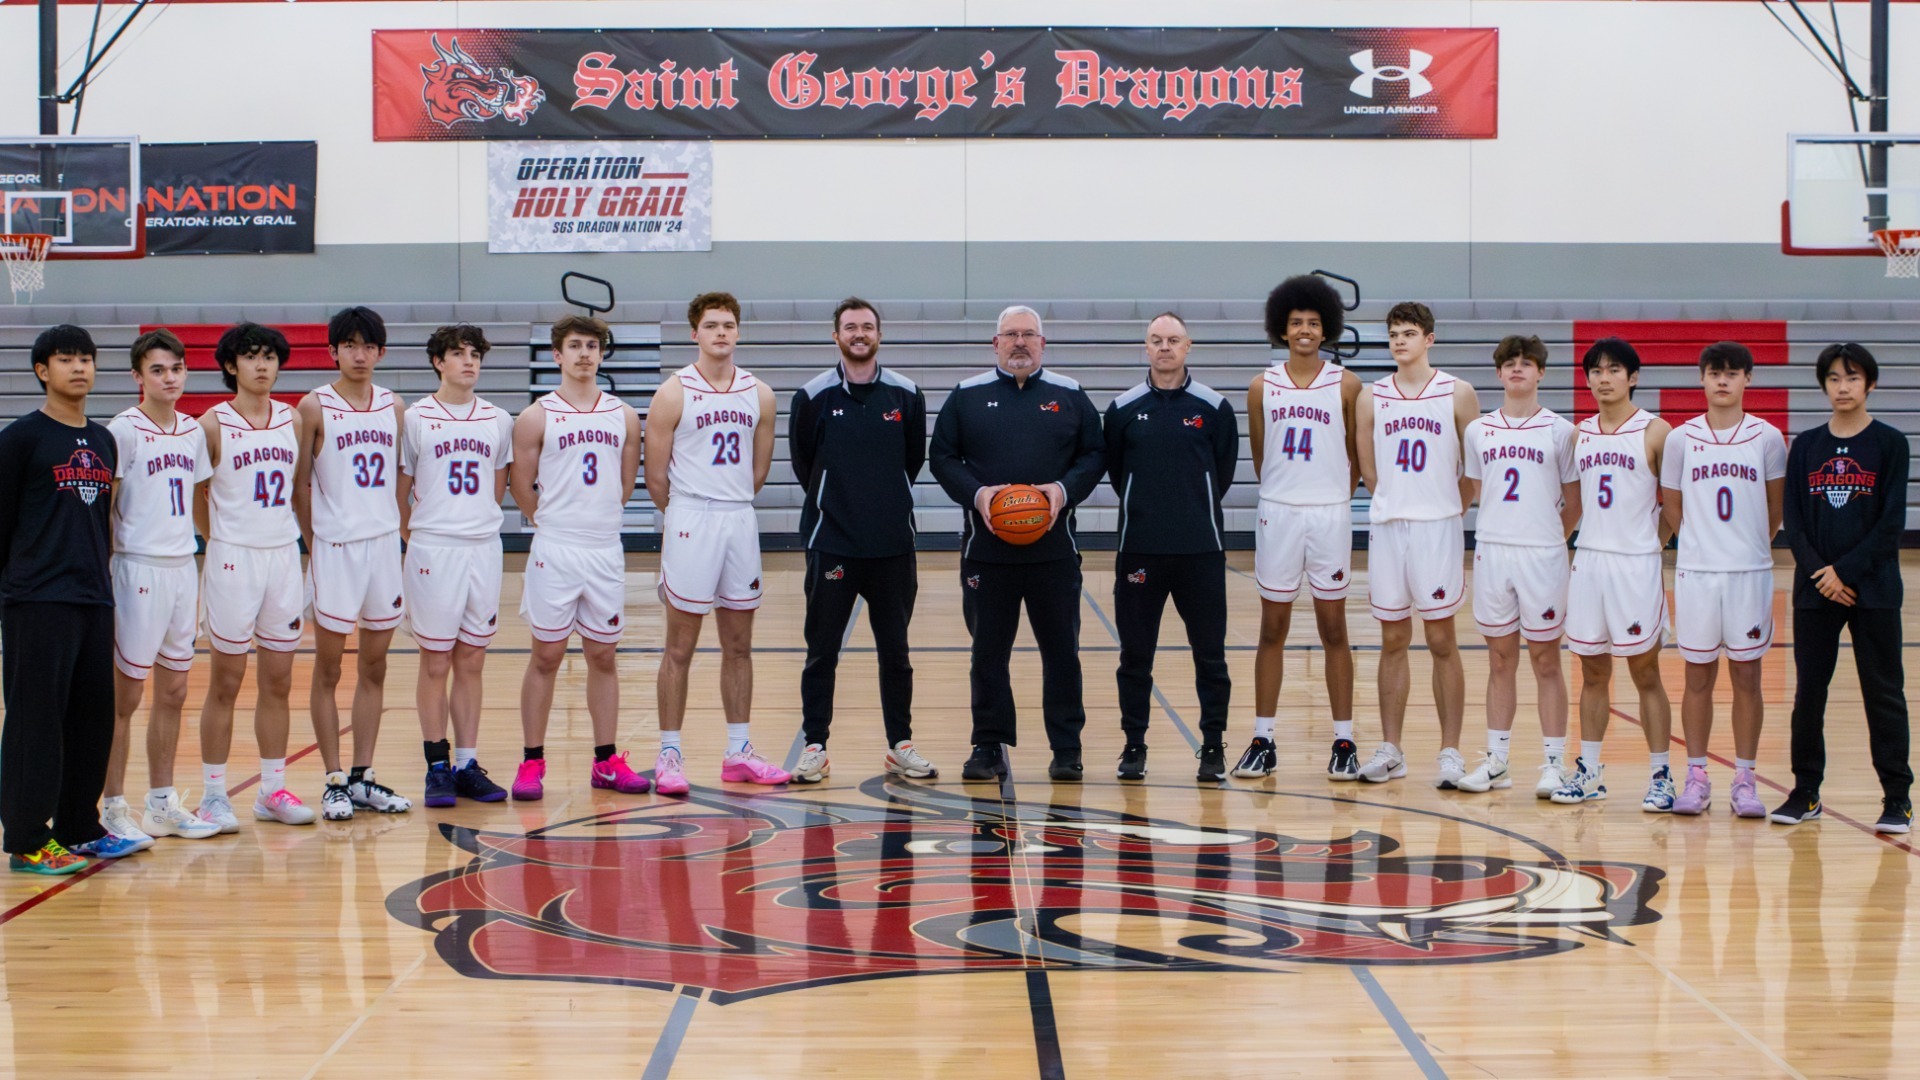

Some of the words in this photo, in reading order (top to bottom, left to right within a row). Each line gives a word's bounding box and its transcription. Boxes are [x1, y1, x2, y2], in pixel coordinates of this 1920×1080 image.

[571, 51, 740, 111] Saint
[768, 50, 1025, 121] George's
[1055, 49, 1304, 121] Dragons
[1344, 106, 1384, 114] UNDER
[1386, 106, 1438, 114] ARMOUR
[517, 157, 644, 180] OPERATION
[146, 183, 296, 212] NATION
[512, 187, 593, 218] HOLY
[597, 186, 687, 217] GRAIL
[124, 217, 210, 228] OERATION:
[212, 215, 251, 227] HOLY
[253, 215, 297, 226] GRAIL
[553, 221, 574, 234] SGS
[576, 221, 620, 233] DRAGON
[622, 221, 661, 233] NATION
[696, 410, 753, 429] DRAGONS
[1271, 405, 1331, 425] DRAGONS
[1384, 416, 1442, 436] DRAGONS
[336, 430, 393, 450] DRAGONS
[434, 438, 491, 459] DRAGONS
[558, 430, 620, 450] DRAGONS
[711, 432, 741, 465] 23
[1283, 427, 1313, 462] 44
[147, 453, 194, 477] DRAGONS
[233, 447, 294, 470] DRAGONS
[1396, 439, 1427, 472] 40
[1482, 445, 1544, 465] DRAGONS
[1579, 452, 1636, 473] DRAGONS
[352, 452, 386, 488] 32
[448, 460, 480, 495] 55
[582, 452, 598, 486] 3
[1692, 463, 1758, 482] DRAGONS
[1808, 474, 1876, 486] DRAGONS
[253, 470, 286, 508] 42
[1503, 467, 1520, 501] 2
[1598, 475, 1613, 509] 5
[168, 478, 185, 516] 11
[1716, 486, 1734, 522] 0
